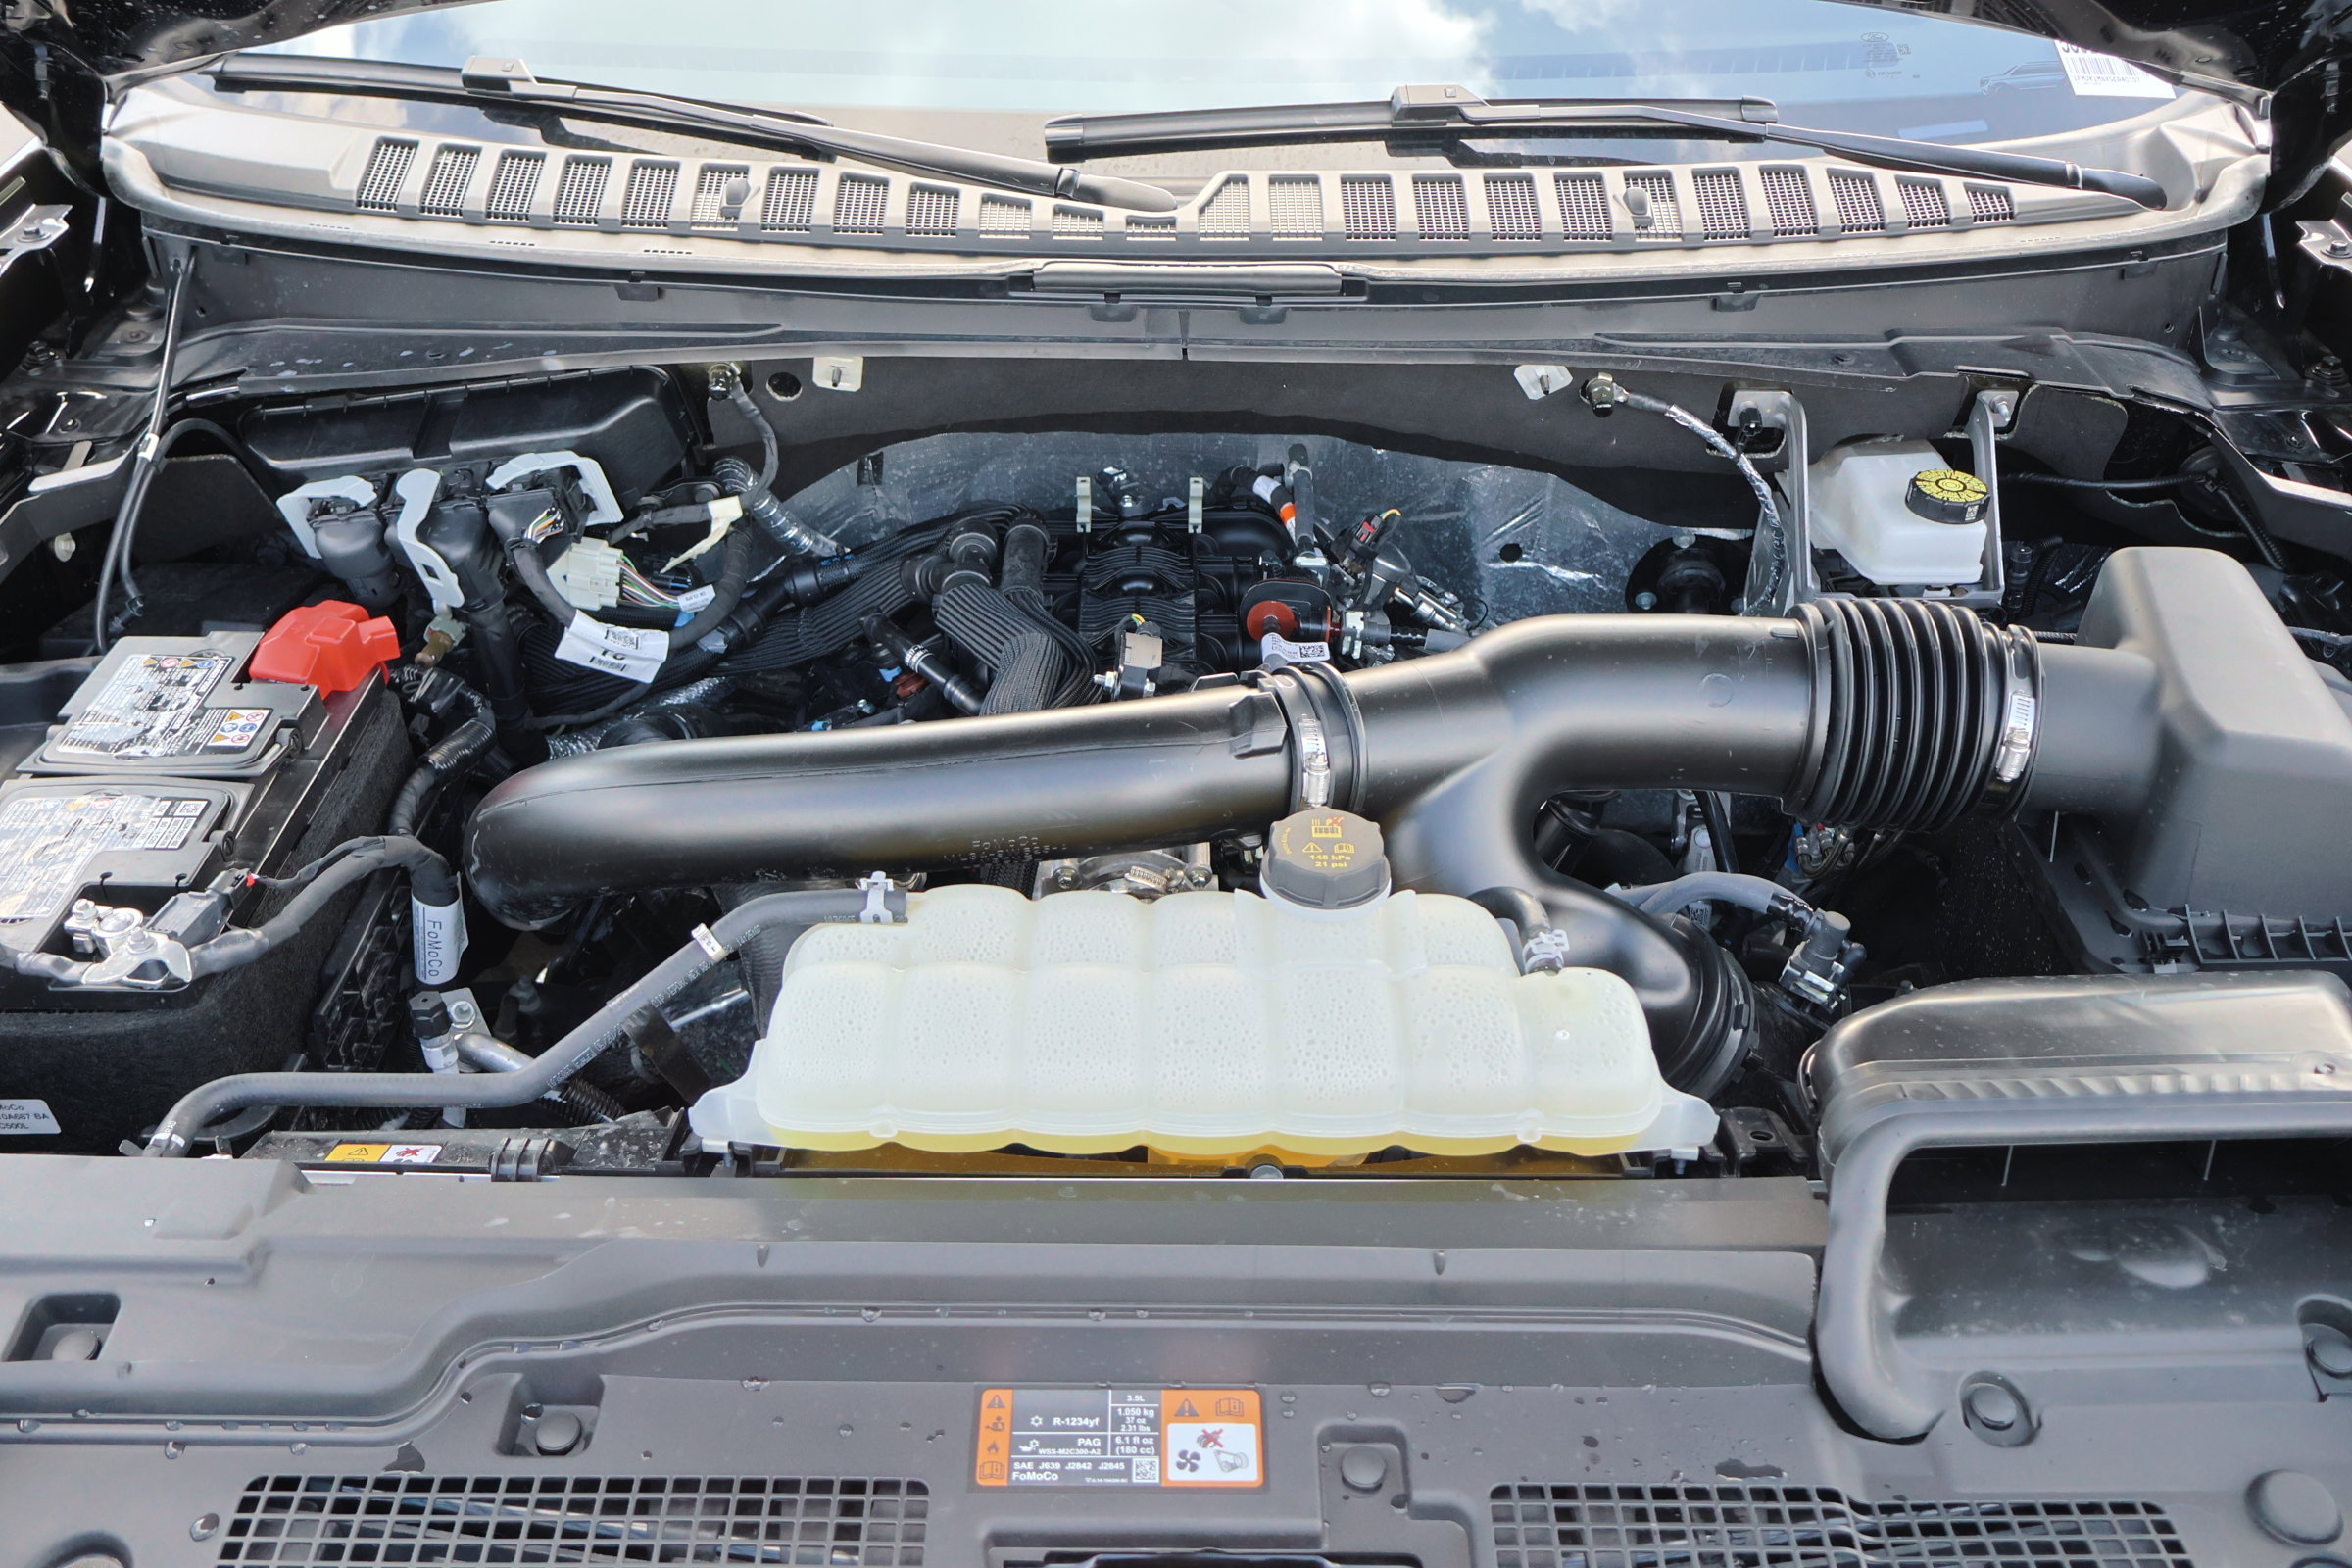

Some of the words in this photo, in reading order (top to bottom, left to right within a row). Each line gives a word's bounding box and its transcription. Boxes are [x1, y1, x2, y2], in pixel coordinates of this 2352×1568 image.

[426, 919, 443, 977] FoMoCo
[1126, 1394, 1146, 1402] 3.5L
[1116, 1407, 1142, 1416] 1.050
[1143, 1407, 1155, 1418] kg
[1053, 1417, 1100, 1428] R-1234yf
[1077, 1438, 1102, 1446] PAG
[1114, 1436, 1131, 1445] 6.1
[1132, 1436, 1140, 1445] fl
[1115, 1446, 1138, 1456] (180
[1139, 1446, 1156, 1456] cc)
[1012, 1461, 1035, 1470] SAE
[1038, 1461, 1061, 1470] J639
[1065, 1461, 1093, 1470] J2842
[1097, 1461, 1126, 1470] J2845
[1011, 1471, 1059, 1481] FoMoCo
